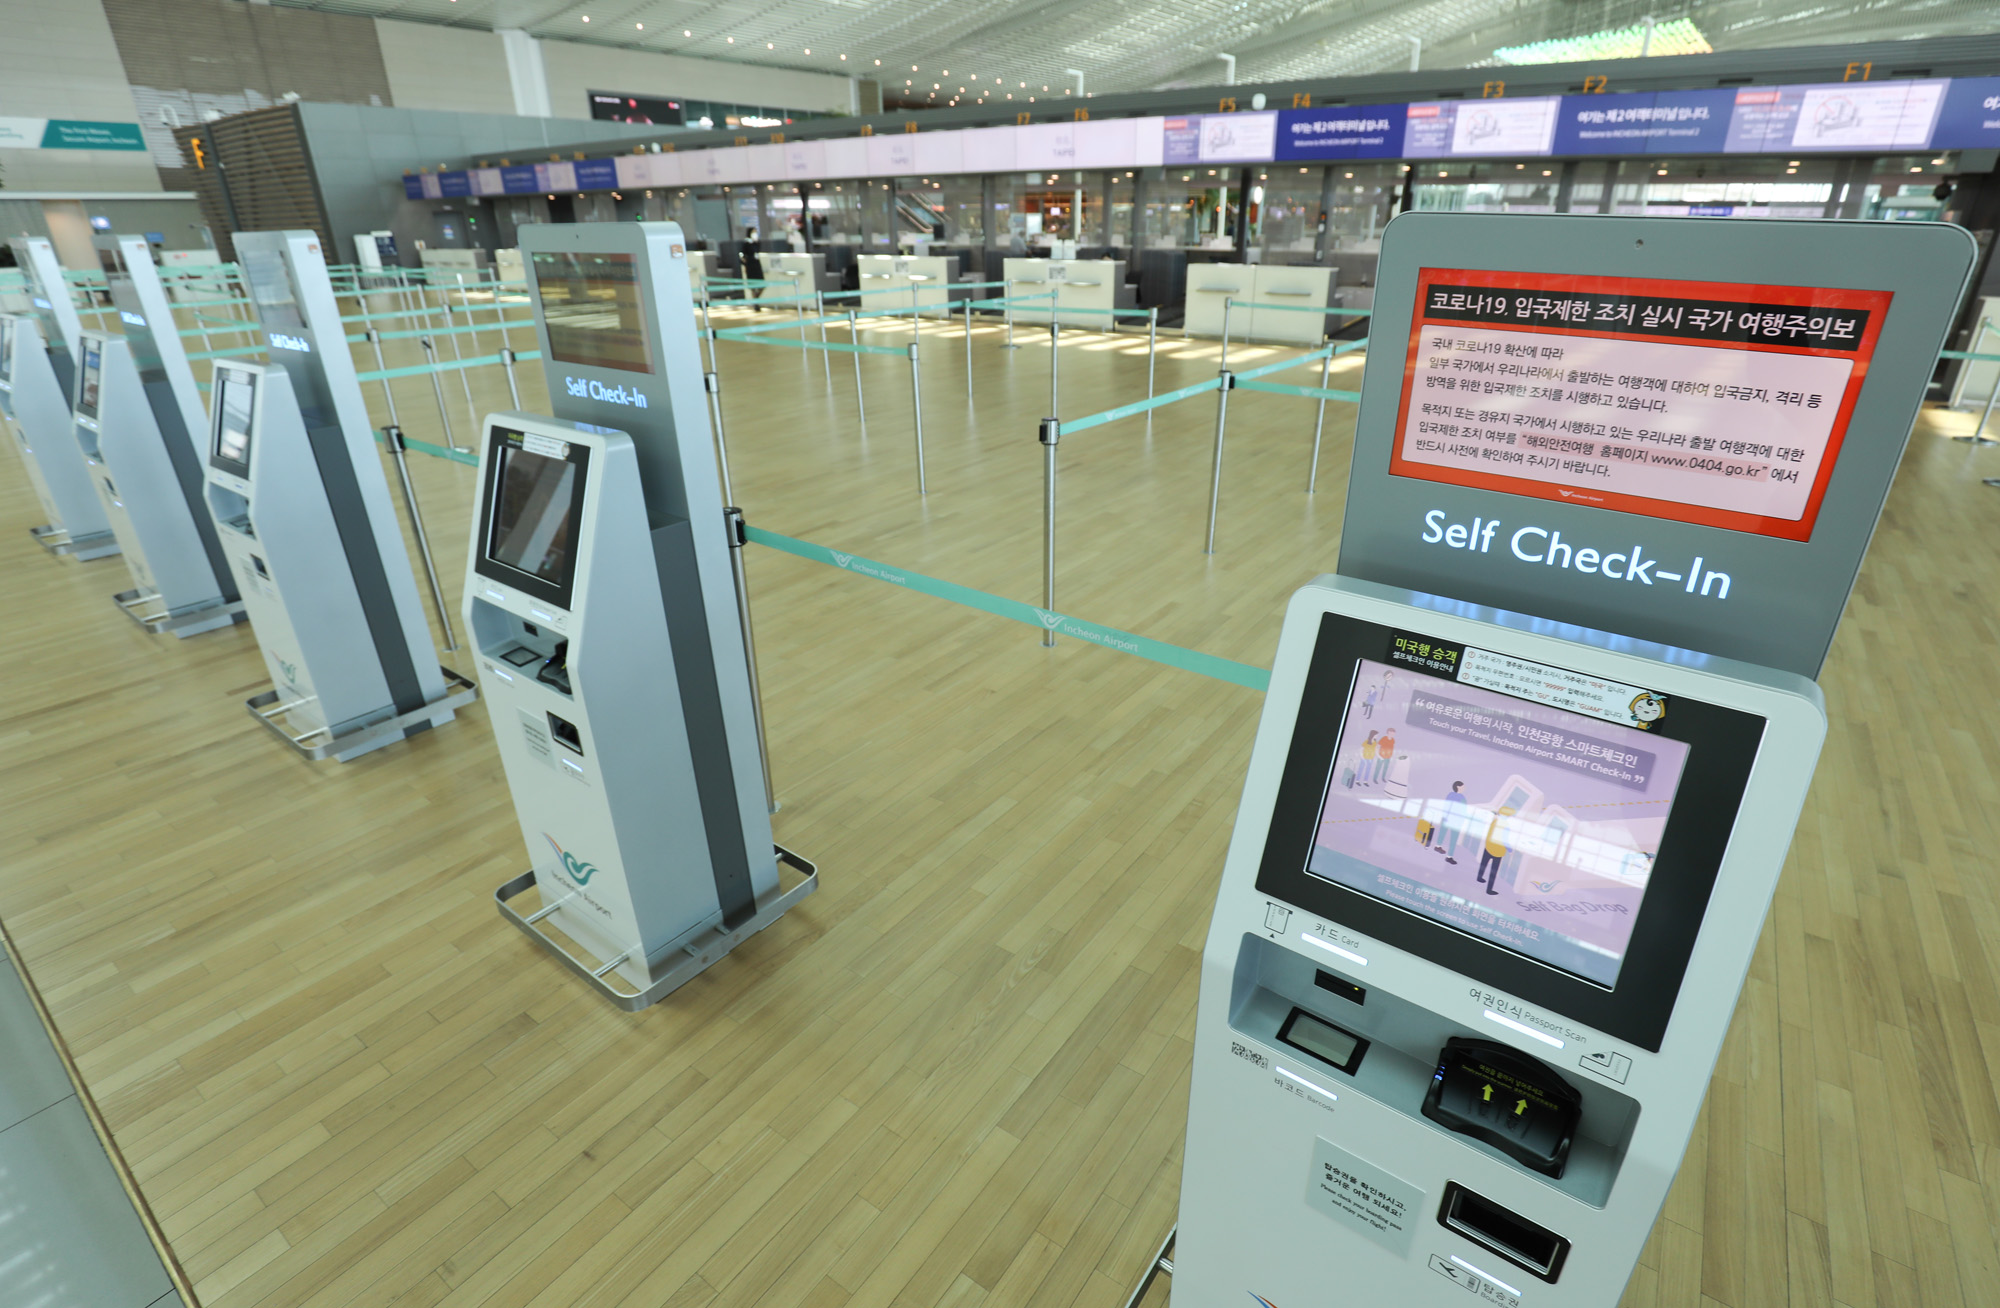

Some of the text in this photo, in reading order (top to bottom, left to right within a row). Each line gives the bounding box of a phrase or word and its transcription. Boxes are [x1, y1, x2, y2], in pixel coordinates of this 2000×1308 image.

[1843, 61, 1872, 82] F1
[1483, 80, 1505, 99] F3
[1583, 75, 1607, 94] F2
[1219, 97, 1236, 113] F5
[1293, 92, 1311, 109] F4
[1017, 112, 1031, 126] F7
[1074, 108, 1089, 122] F6
[1429, 292, 1857, 341] 코로나19, 입국제한 조치 실시 국가 여행주의보
[1431, 338, 1565, 361] 국내 코로나19 확산에 따라
[565, 376, 648, 409] Self Check-In
[1426, 375, 1668, 414] 방역을 위한 입국제한 조치를 시행하고 있습니다.
[1429, 357, 1822, 408] 일부 국가에서 우리나라에서 출발하는 여행객에 대하여 입국금지, 격리 등
[1421, 403, 1805, 464] 목적지 또는 경유지 국가에서 시행하고 있는 우리나라 출발 여행객에 대한
[1416, 439, 1611, 478] 반드시 사전에 확인하여 주시기 바랍니다.
[1419, 421, 1459, 437] 입국제한
[1461, 427, 1483, 441] 조치
[1485, 430, 1517, 445] 여부를
[1600, 444, 1649, 463] 홈페이지
[1770, 467, 1799, 484] 에서
[1422, 509, 1732, 600] Self Check-In
[851, 561, 906, 585] Incheon Airport
[1063, 623, 1139, 653] Incheon Airport
[1392, 650, 1455, 673] 셀프체크인 이용안내
[1395, 638, 1458, 664] 미국행 승객
[1429, 717, 1450, 730] Touch
[1450, 725, 1467, 737] your
[1468, 728, 1491, 743] Travel,
[1492, 734, 1524, 751] Incheon
[1525, 742, 1554, 760] Airport
[1555, 752, 1589, 770] SMART
[1464, 711, 1492, 729] 여행의
[1492, 720, 1515, 735] 시작,
[1518, 725, 1565, 748] 인천공항
[1566, 740, 1639, 769] 스마트체크인
[1516, 900, 1629, 917] Self Bag Drop
[1341, 935, 1360, 949] Card
[1469, 988, 1588, 1044] 여권인식 Passport Scan
[1306, 1095, 1336, 1113] Barcode
